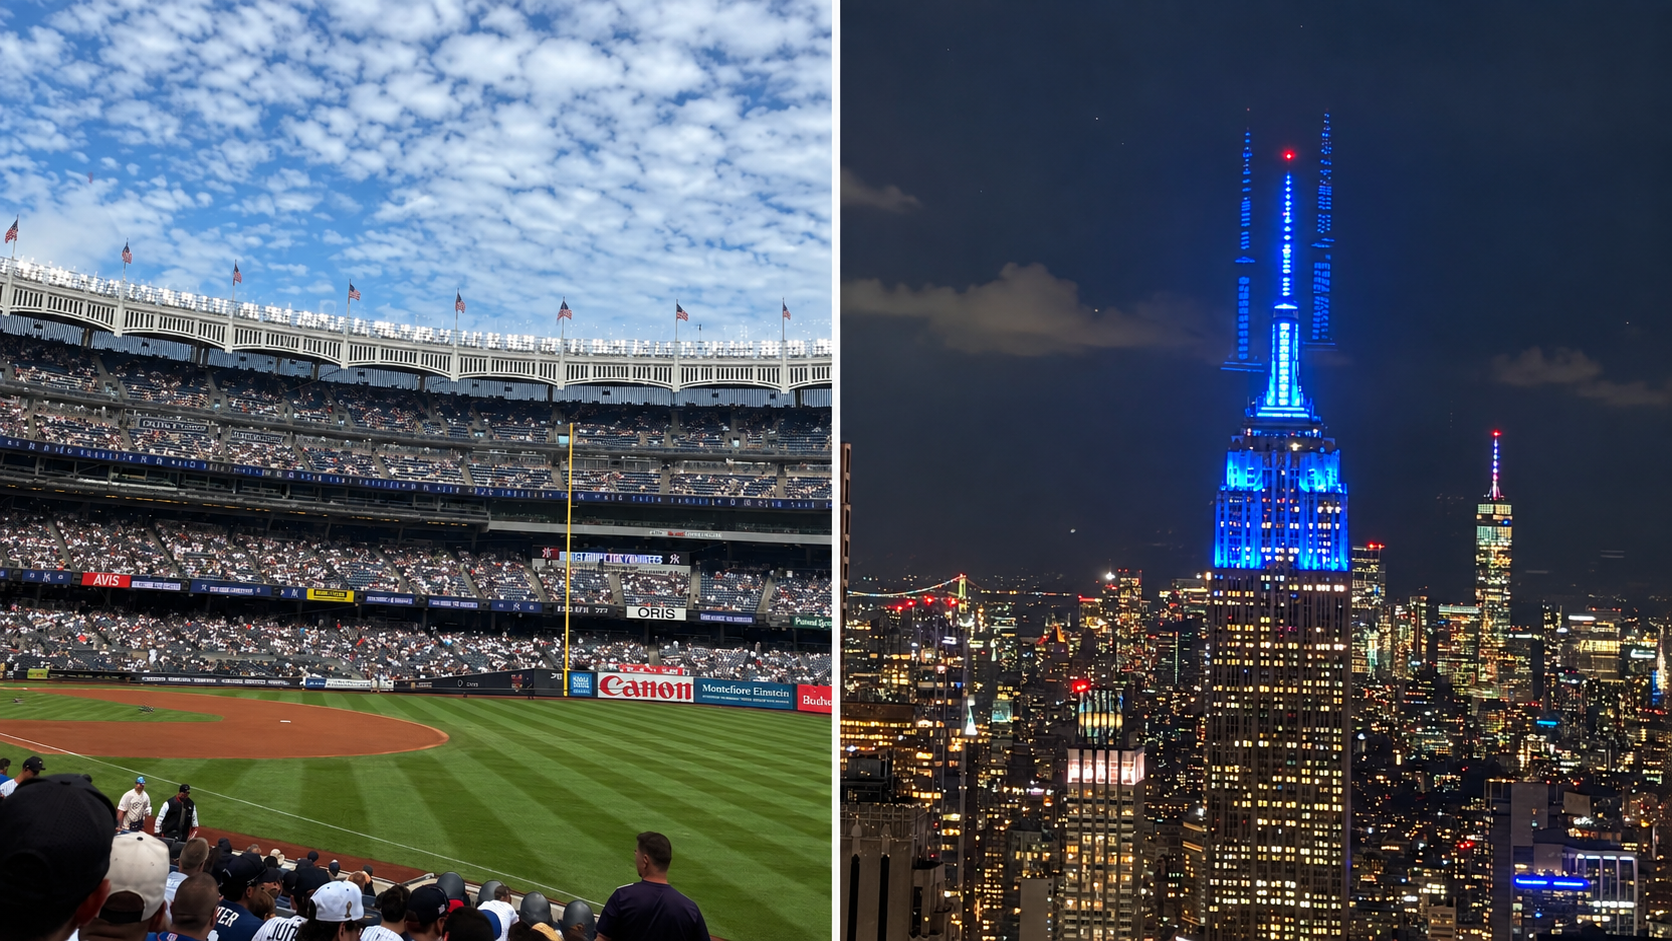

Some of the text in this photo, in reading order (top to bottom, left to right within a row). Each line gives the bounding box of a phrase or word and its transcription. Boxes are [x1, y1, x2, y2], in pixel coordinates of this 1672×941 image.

[93, 574, 120, 586] AVIS
[638, 607, 675, 619] ORIS
[599, 675, 692, 700] Canon
[702, 684, 789, 697] Montefiore Einstein
